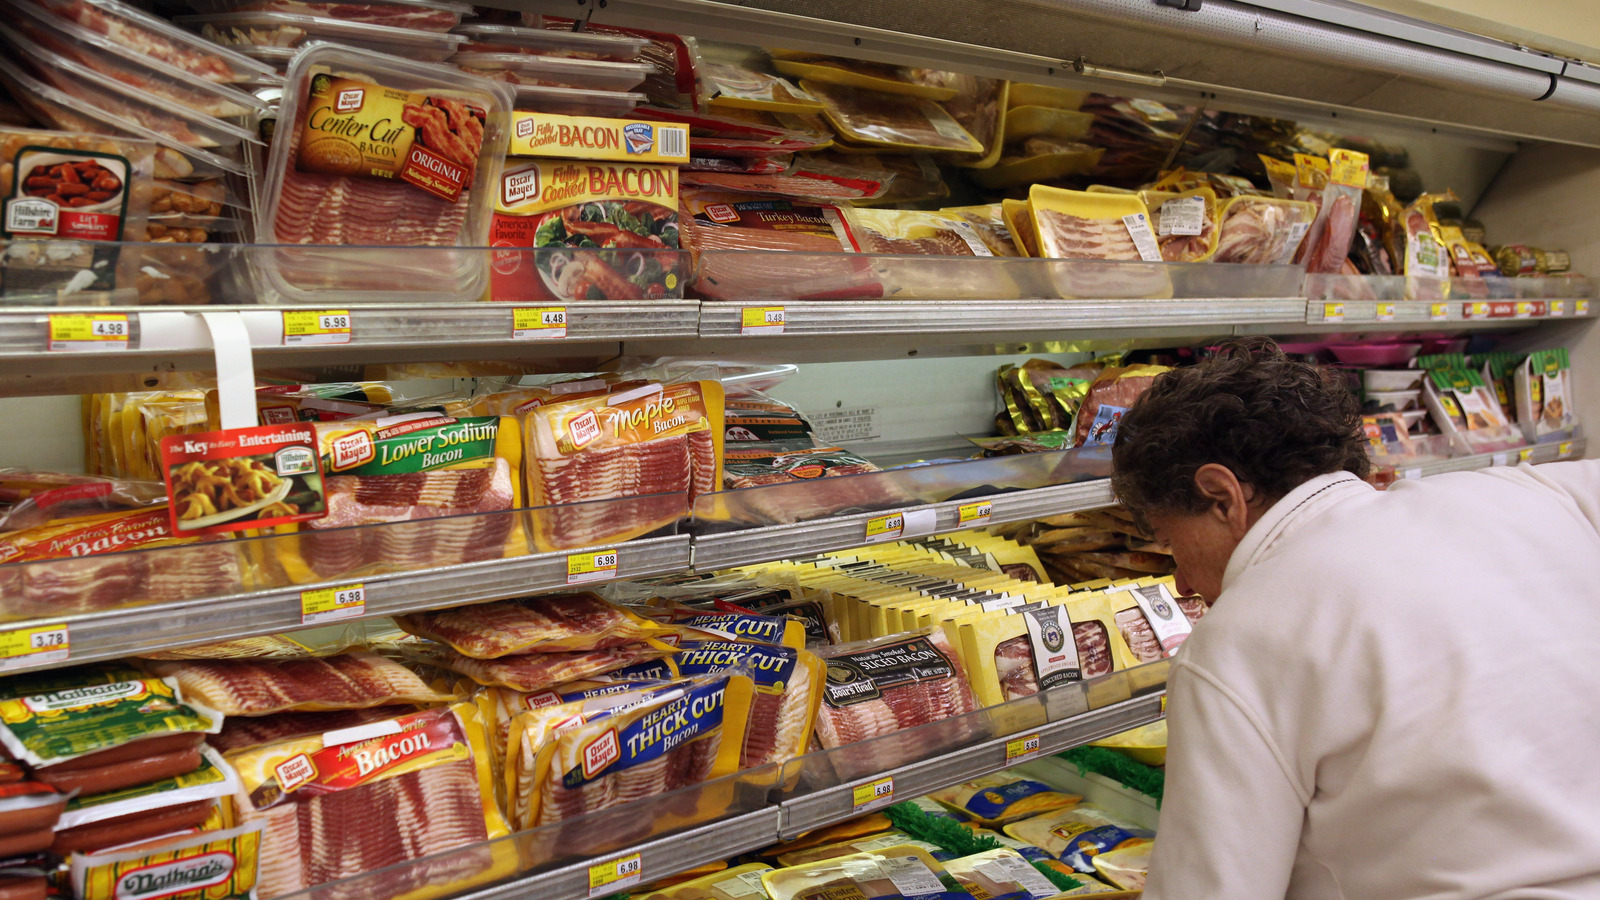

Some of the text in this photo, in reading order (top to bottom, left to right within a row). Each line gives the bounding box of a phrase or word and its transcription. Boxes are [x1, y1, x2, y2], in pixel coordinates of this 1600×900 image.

[308, 106, 406, 145] Center Cut
[536, 123, 554, 137] Fully
[529, 132, 559, 149] Cooked
[558, 125, 620, 150] BACON
[360, 142, 398, 158] BACON
[411, 149, 461, 183] ORIGINAL
[551, 165, 580, 184] Fully
[509, 174, 531, 187] Oscar
[586, 166, 674, 198] BACON
[508, 182, 534, 199] Mayer
[541, 178, 587, 204] Cooked
[14, 204, 52, 218] Hillshire
[756, 211, 829, 225] Turkey Bacon
[14, 218, 37, 228] Farm
[495, 219, 534, 230] America's
[495, 230, 527, 240] Favorite
[323, 316, 347, 328] 6.98
[545, 313, 564, 323] 4.48
[767, 313, 783, 323] 3.48
[97, 323, 123, 336] 4.98
[606, 391, 675, 438] Maple
[574, 415, 593, 432] Oscar
[575, 423, 597, 441] Mayer
[653, 415, 686, 435] Bacon
[184, 440, 209, 456] Key
[238, 429, 312, 448] Entertaining
[340, 437, 364, 451] Oscar
[380, 423, 499, 467] Lower Sodium
[340, 446, 368, 463] Mayer
[422, 447, 463, 469] Bacon
[48, 517, 166, 553] America's Favorite
[68, 525, 169, 557] Bacon
[598, 555, 615, 566] 6.98
[339, 591, 361, 604] 6.98
[692, 614, 743, 625] HEARTY
[734, 619, 779, 637] CUT
[36, 633, 64, 648] 3.78
[700, 641, 755, 653] HEARTY
[679, 650, 790, 673] THICK CUT
[850, 652, 882, 664] Naturally
[860, 649, 938, 670] SLICED BACON
[583, 684, 630, 699] HEARTY
[829, 684, 855, 700] Boar's
[854, 680, 875, 694] Head
[533, 694, 554, 706] Oscar
[642, 693, 692, 730] HEARTY
[627, 688, 725, 759] THICK CUT
[591, 734, 611, 757] Oscar
[663, 723, 699, 753] Bacon
[354, 732, 431, 777] Bacon
[590, 744, 615, 768] Mayer
[281, 759, 304, 775] Oscar
[876, 784, 891, 796] 5.98
[124, 859, 224, 892] Nathan's
[620, 860, 638, 874] 6.98
